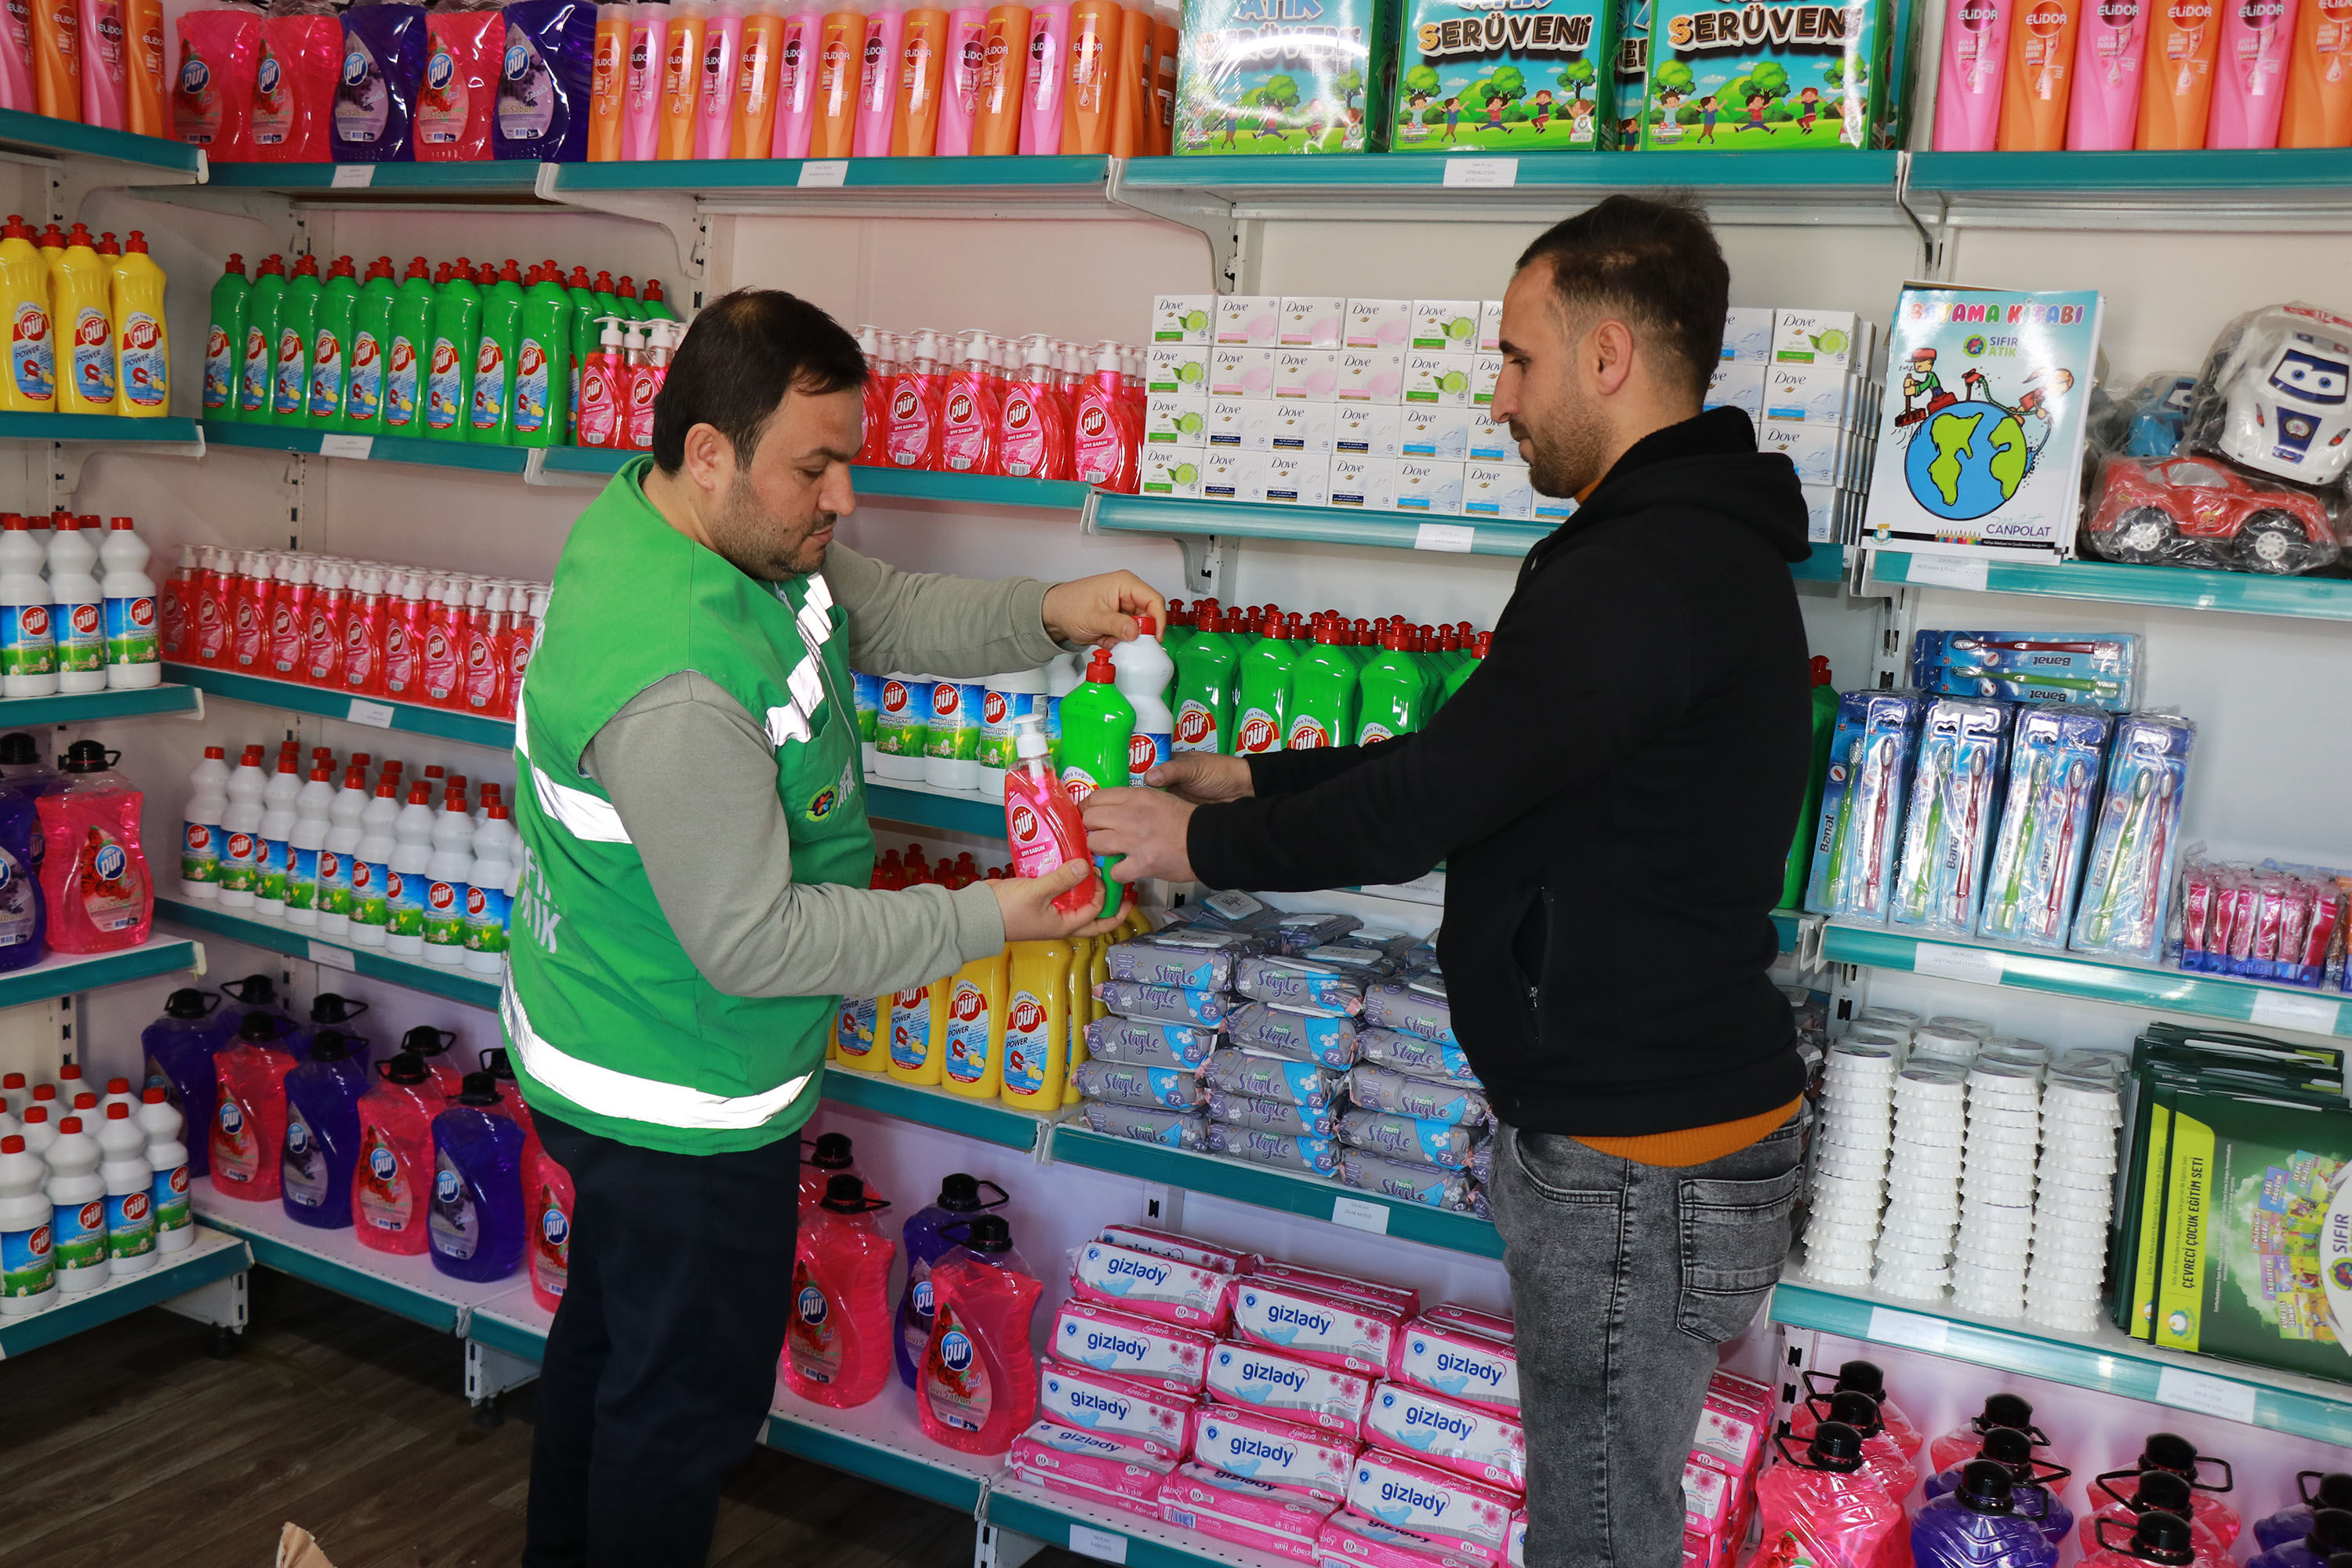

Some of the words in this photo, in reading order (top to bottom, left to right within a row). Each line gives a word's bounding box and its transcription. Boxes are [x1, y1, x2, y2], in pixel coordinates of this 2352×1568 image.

[508, 52, 526, 80] pür
[958, 50, 983, 61] ELiDO
[346, 58, 365, 85] pür
[431, 59, 451, 89] pür
[1159, 299, 1184, 311] Dove
[1223, 300, 1249, 312] Dove
[1286, 301, 1314, 313] Dove
[1352, 303, 1380, 315] Dove
[1418, 304, 1446, 316] Dove
[24, 315, 42, 339] pür
[1783, 314, 1816, 328] Dove
[85, 321, 104, 345] pür
[134, 325, 155, 350] pür
[1990, 336, 2019, 347] SIFIR
[1152, 350, 1178, 361] Dove
[1217, 351, 1243, 363] Dove
[1280, 353, 1308, 366] Dove
[1344, 355, 1371, 367] Dove
[1988, 347, 2016, 357] ATIK
[1411, 357, 1440, 370] Dove
[1479, 358, 1503, 371] Dov
[1774, 371, 1806, 385] Dove
[896, 394, 916, 419] pür
[951, 398, 971, 422] pür
[1007, 403, 1029, 428] pür
[1152, 400, 1178, 412] Dove
[1214, 402, 1241, 415] Dove
[1278, 405, 1305, 418] Dove
[1341, 408, 1369, 421] Dove
[1407, 410, 1436, 423] Dove
[1083, 411, 1105, 436] pür
[1768, 428, 1800, 442] Dove
[1148, 450, 1173, 462] Dove
[1209, 453, 1236, 466] Dove
[1271, 457, 1298, 470] Dove
[1337, 460, 1364, 474] Dove
[1402, 463, 1431, 477] Dove
[1471, 468, 1501, 481] Dove
[1986, 524, 2052, 537] CANPOLAT
[2033, 656, 2071, 666] Banat
[884, 687, 904, 711] pür
[935, 689, 956, 713] pür
[2029, 689, 2067, 702] Banat
[1181, 714, 1205, 743] pür
[1245, 722, 1270, 751] pür
[1296, 729, 1319, 750] pür
[1014, 811, 1033, 837] pür
[1819, 813, 1836, 854] Banat
[100, 848, 123, 881] pür
[1256, 971, 1300, 996] Style
[840, 1000, 859, 1011] POWER
[957, 995, 978, 1019] pür
[1137, 986, 1178, 1010] Style
[892, 1013, 911, 1024] POWER
[1016, 1006, 1036, 1032] pür
[948, 1025, 969, 1037] POWER
[1121, 1029, 1160, 1054] Style
[1255, 1025, 1300, 1050] Style
[1007, 1036, 1028, 1049] POWER
[1327, 1052, 1340, 1062] 72
[1392, 1042, 1435, 1067] Style
[1104, 1073, 1142, 1098] Style
[1237, 1073, 1281, 1097] Style
[1169, 1094, 1181, 1103] 72
[1311, 1096, 1323, 1105] 72
[1402, 1096, 1447, 1122] Style
[1246, 1134, 1292, 1159] Style
[1369, 1124, 1412, 1151] Style
[1319, 1157, 1332, 1167] 72
[1440, 1153, 1454, 1163] 72
[2190, 1156, 2203, 1178] SETİ
[2187, 1181, 2201, 1212] EĞİTİM
[85, 1207, 102, 1229] pür
[128, 1197, 147, 1220] pür
[2186, 1214, 2199, 1245] ÇOCUK
[2333, 1214, 2349, 1254] SIFIR
[1107, 1258, 1167, 1286] gizlady
[2182, 1248, 2195, 1289] ÇEVRECİ
[801, 1293, 824, 1323] pür
[1178, 1308, 1187, 1316] 10
[1268, 1305, 1332, 1335] gizlady
[944, 1340, 970, 1369] pür
[1087, 1333, 1147, 1361] gizlady
[1347, 1359, 1356, 1368] 10
[1437, 1353, 1503, 1387] gizlady
[1242, 1363, 1306, 1392] gizlady
[1071, 1392, 1127, 1420] gizlady
[1322, 1415, 1330, 1425] 10
[1406, 1406, 1475, 1442] gizlady
[1059, 1431, 1122, 1452] gizlady
[1230, 1437, 1295, 1468] gizlady
[1700, 1454, 1711, 1464] 10
[1381, 1482, 1447, 1516] gizlady
[1290, 1546, 1312, 1557] zlady
